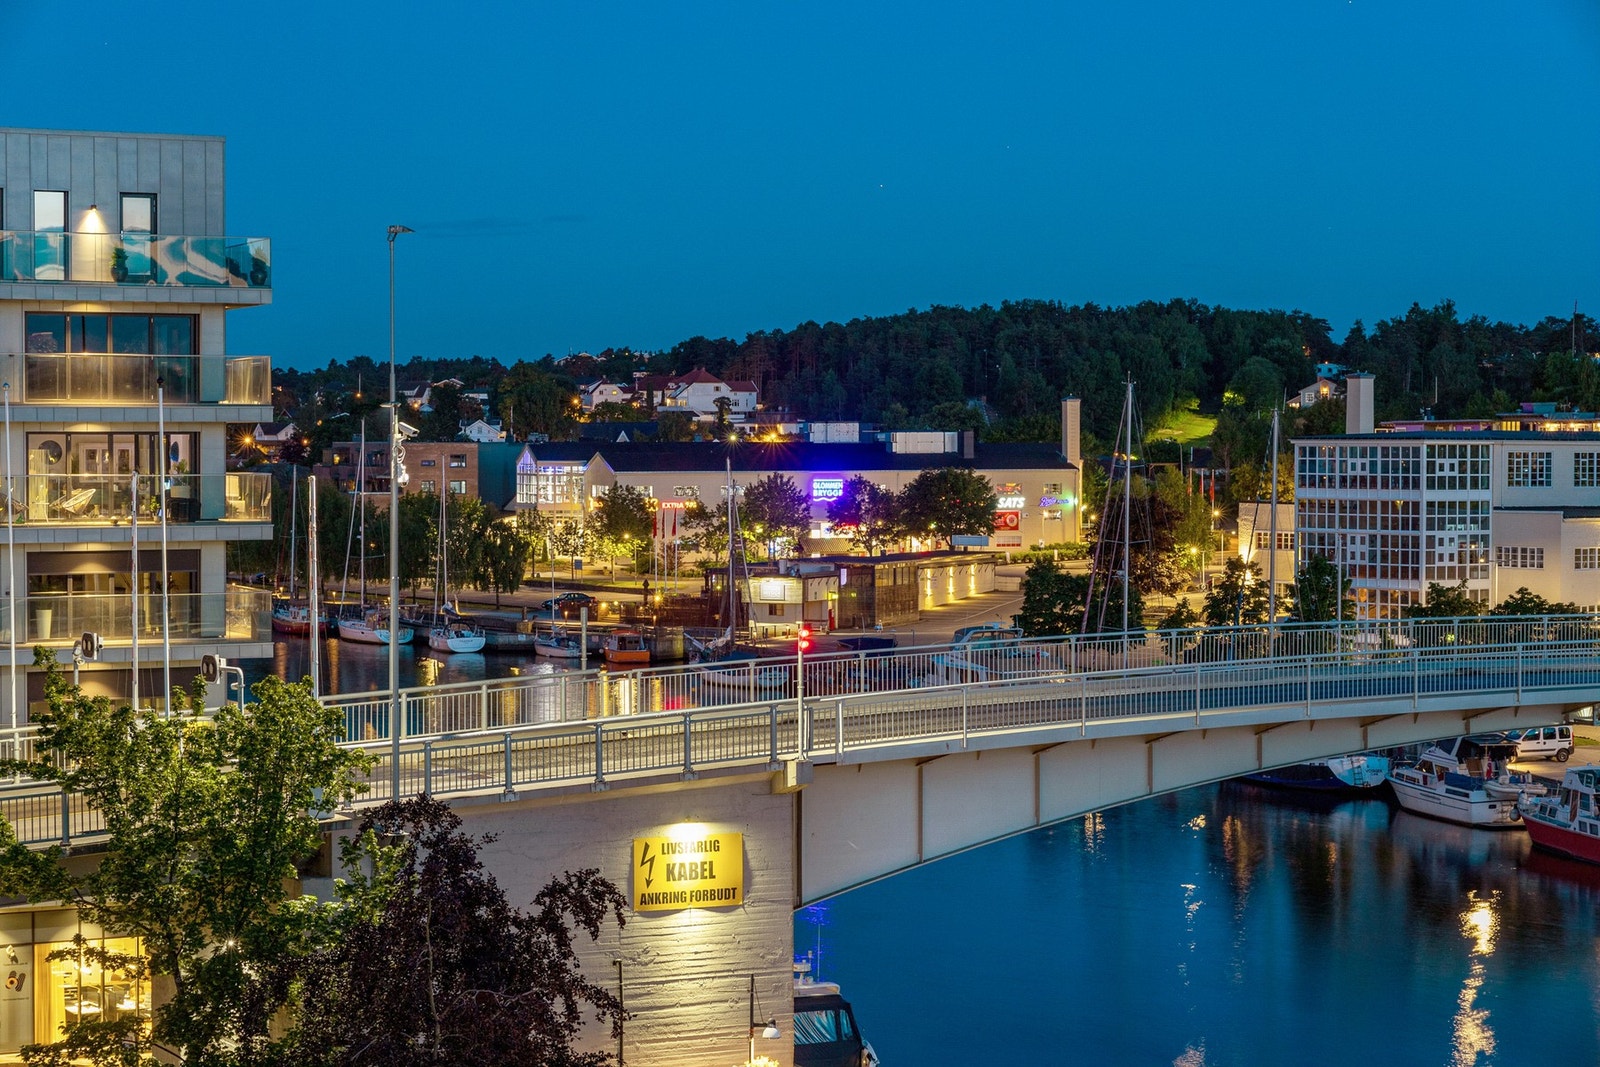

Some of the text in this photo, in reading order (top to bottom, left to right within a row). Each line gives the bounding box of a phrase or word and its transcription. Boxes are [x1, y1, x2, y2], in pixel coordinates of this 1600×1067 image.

[813, 481, 843, 489] GLOMMEN
[997, 497, 1025, 509] SATS
[661, 839, 720, 855] LIVSFARLIG
[666, 860, 716, 882] KABEL
[640, 887, 737, 906] ANKRING FORBUDT
